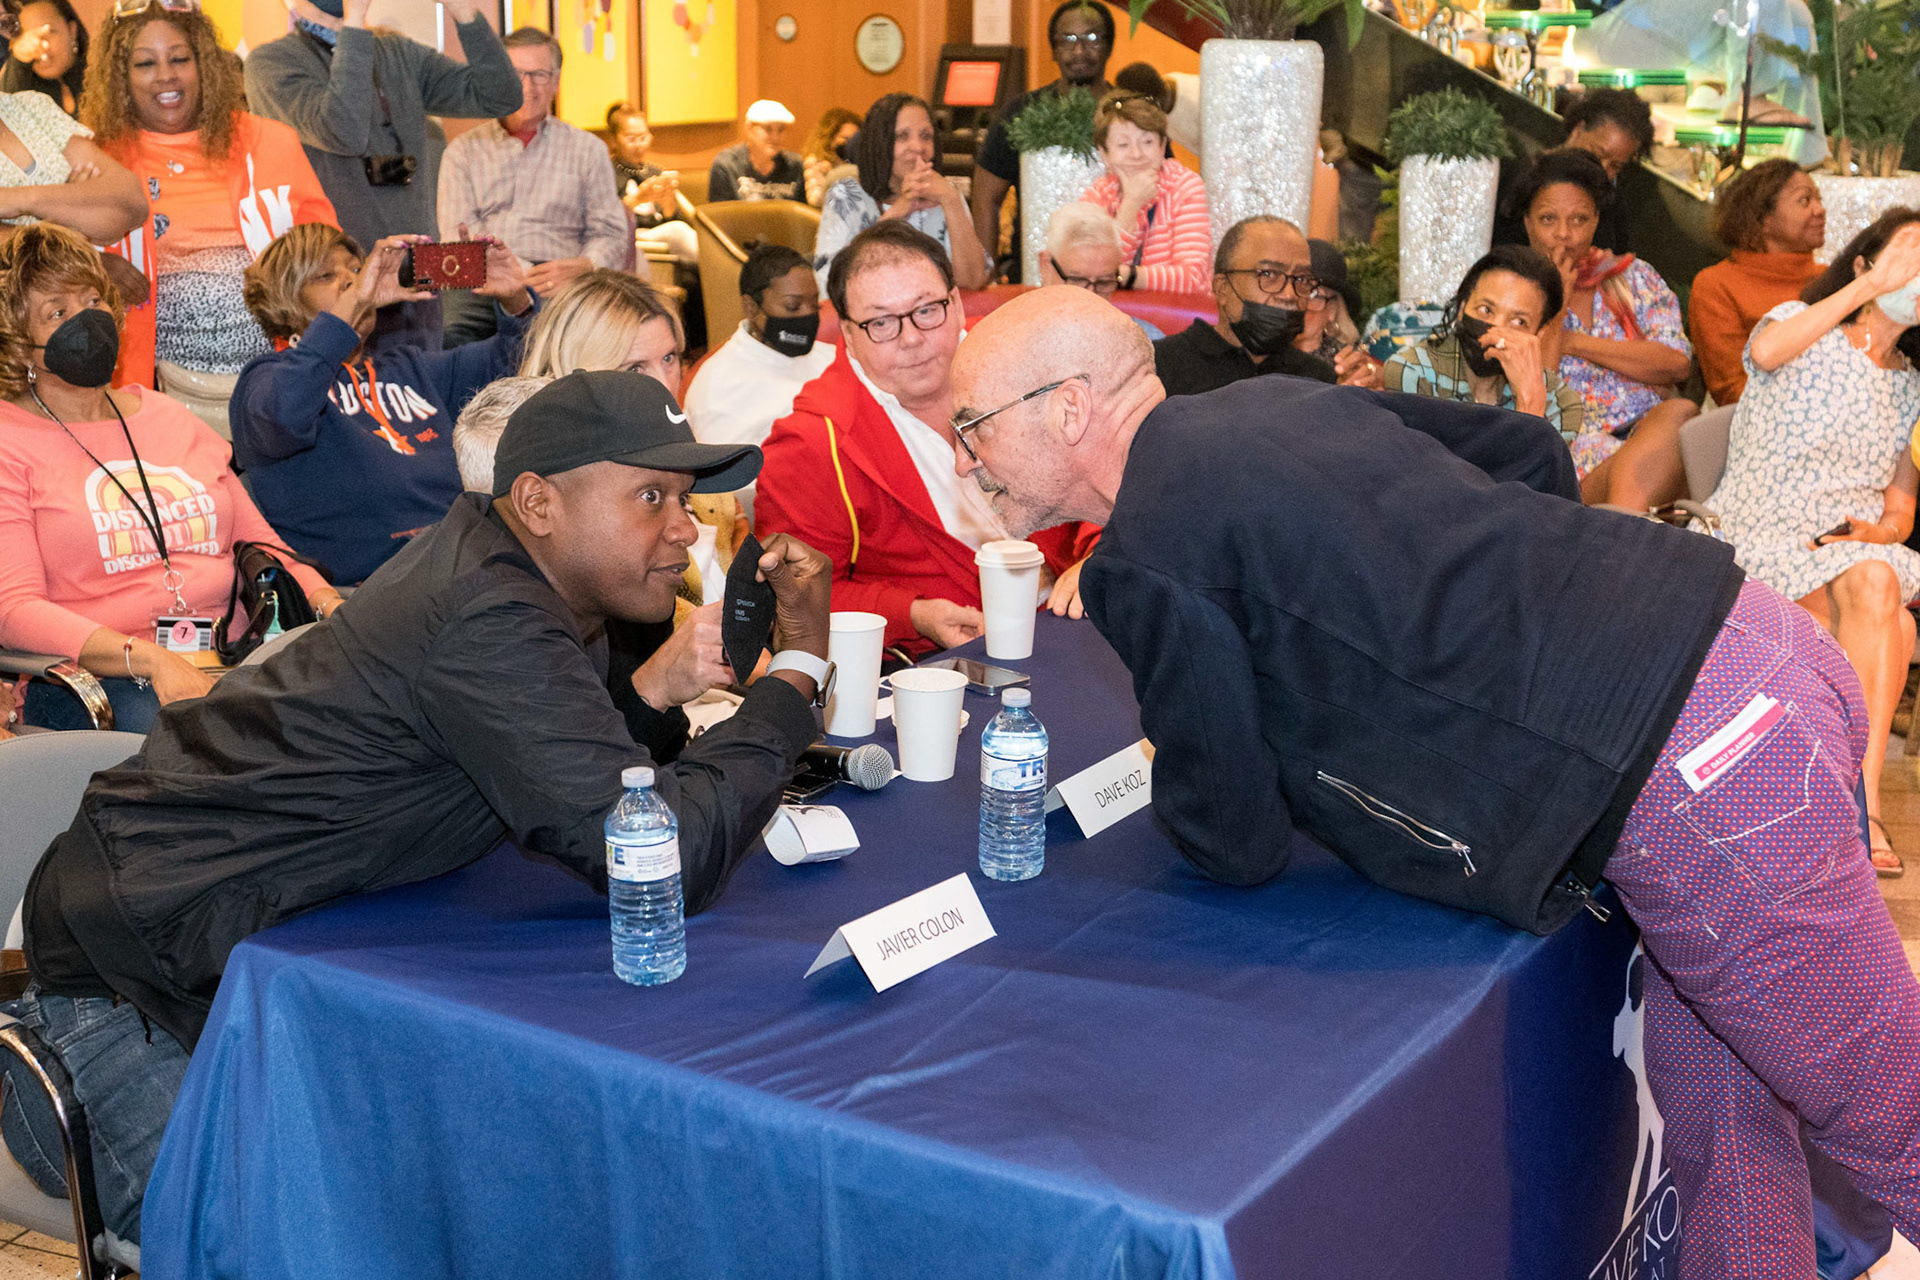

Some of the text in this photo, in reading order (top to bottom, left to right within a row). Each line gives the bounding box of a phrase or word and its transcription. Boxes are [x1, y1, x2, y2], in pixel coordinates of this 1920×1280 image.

[180, 626, 189, 639] 7
[1017, 759, 1047, 778] TR
[1710, 732, 1757, 770] DAILY PLANNER
[1094, 769, 1147, 808] DAVE KOZ
[876, 907, 965, 961] JAVIER COLON
[1643, 1186, 1682, 1262] KO
